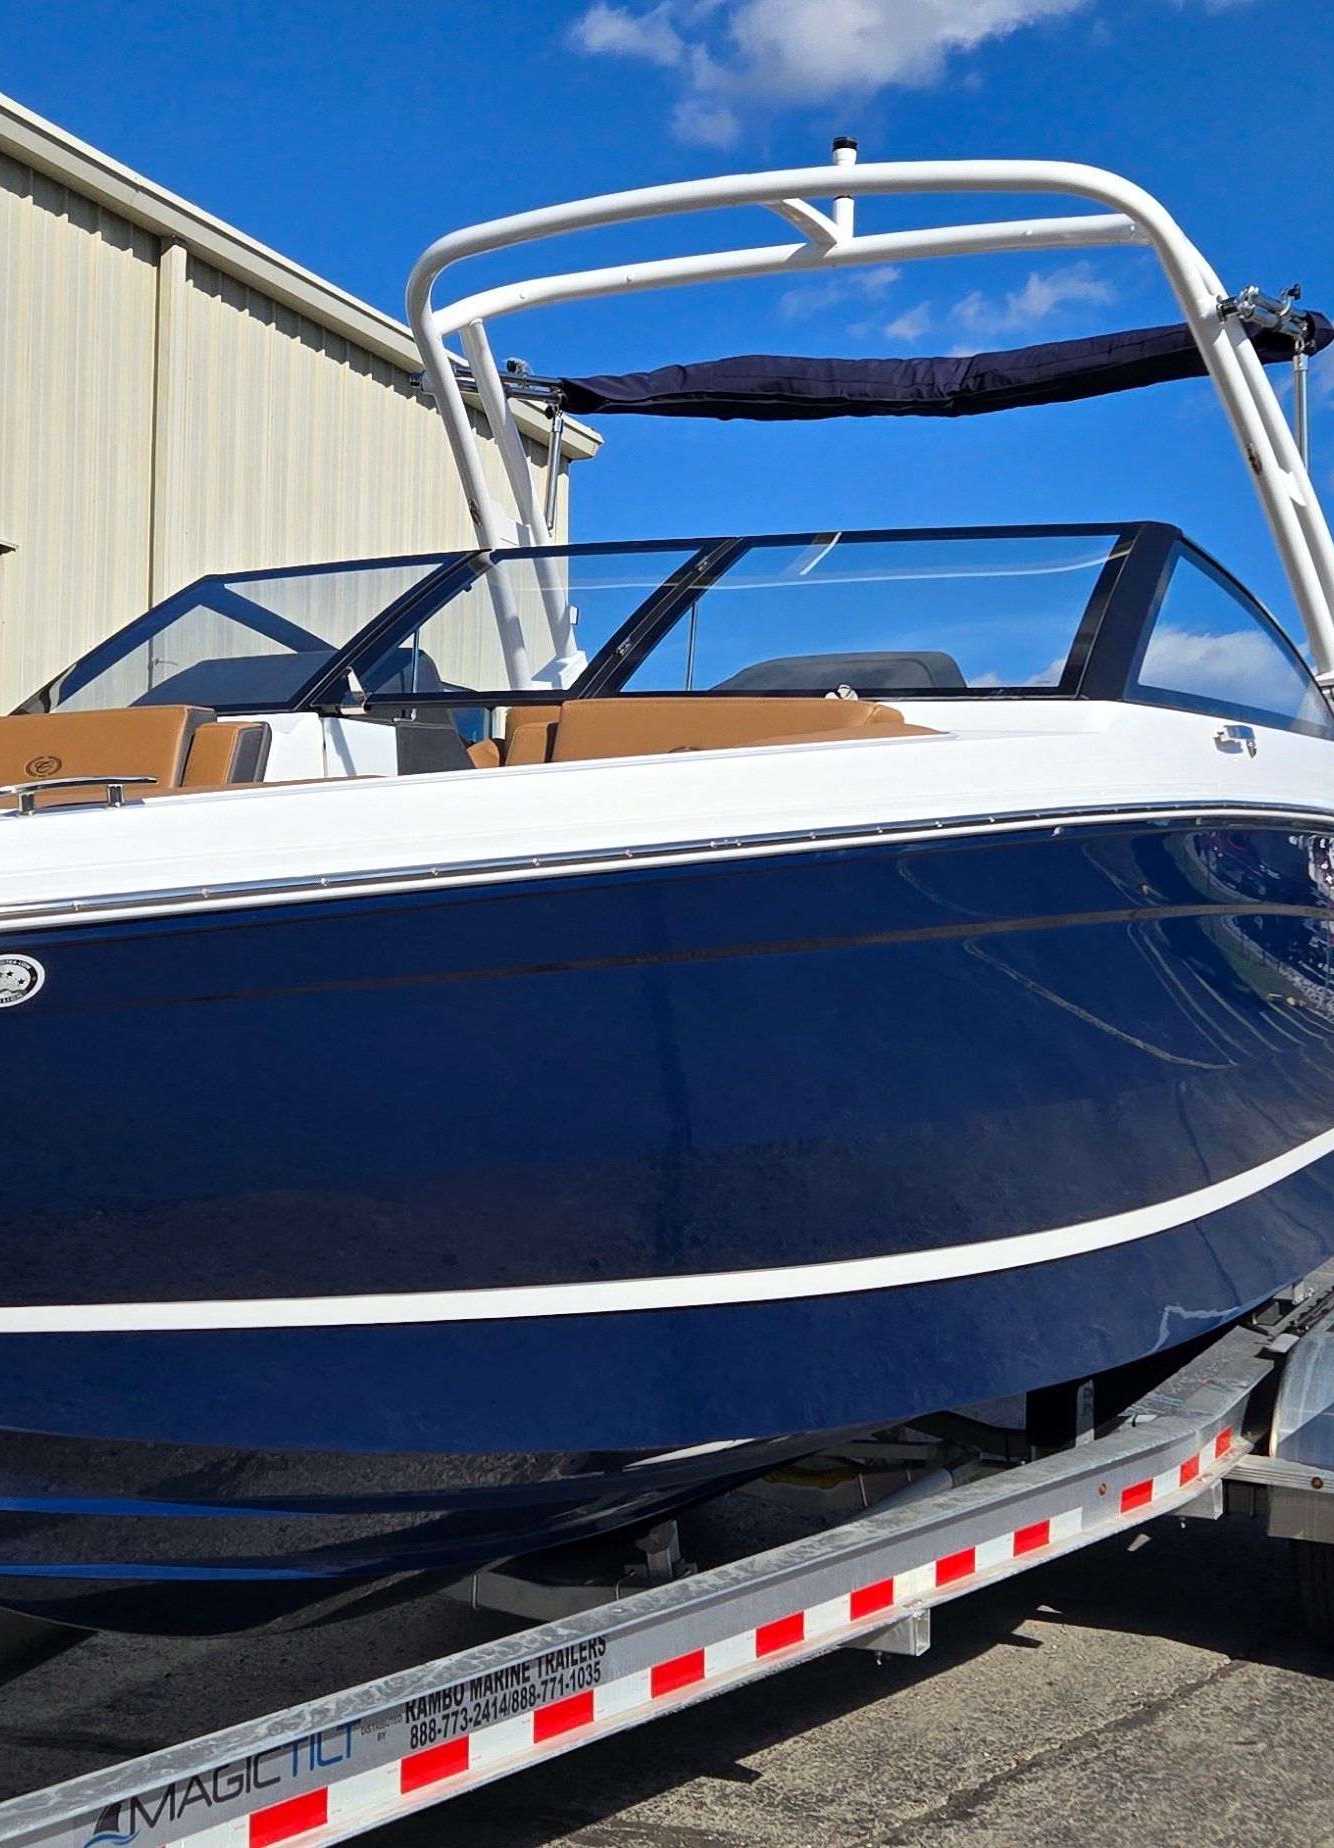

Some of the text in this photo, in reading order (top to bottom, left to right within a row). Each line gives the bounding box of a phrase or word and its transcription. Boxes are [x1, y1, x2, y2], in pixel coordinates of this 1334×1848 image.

[405, 1635, 607, 1723] RAMBO MARINE TRAILERS
[377, 1730, 387, 1742] BY
